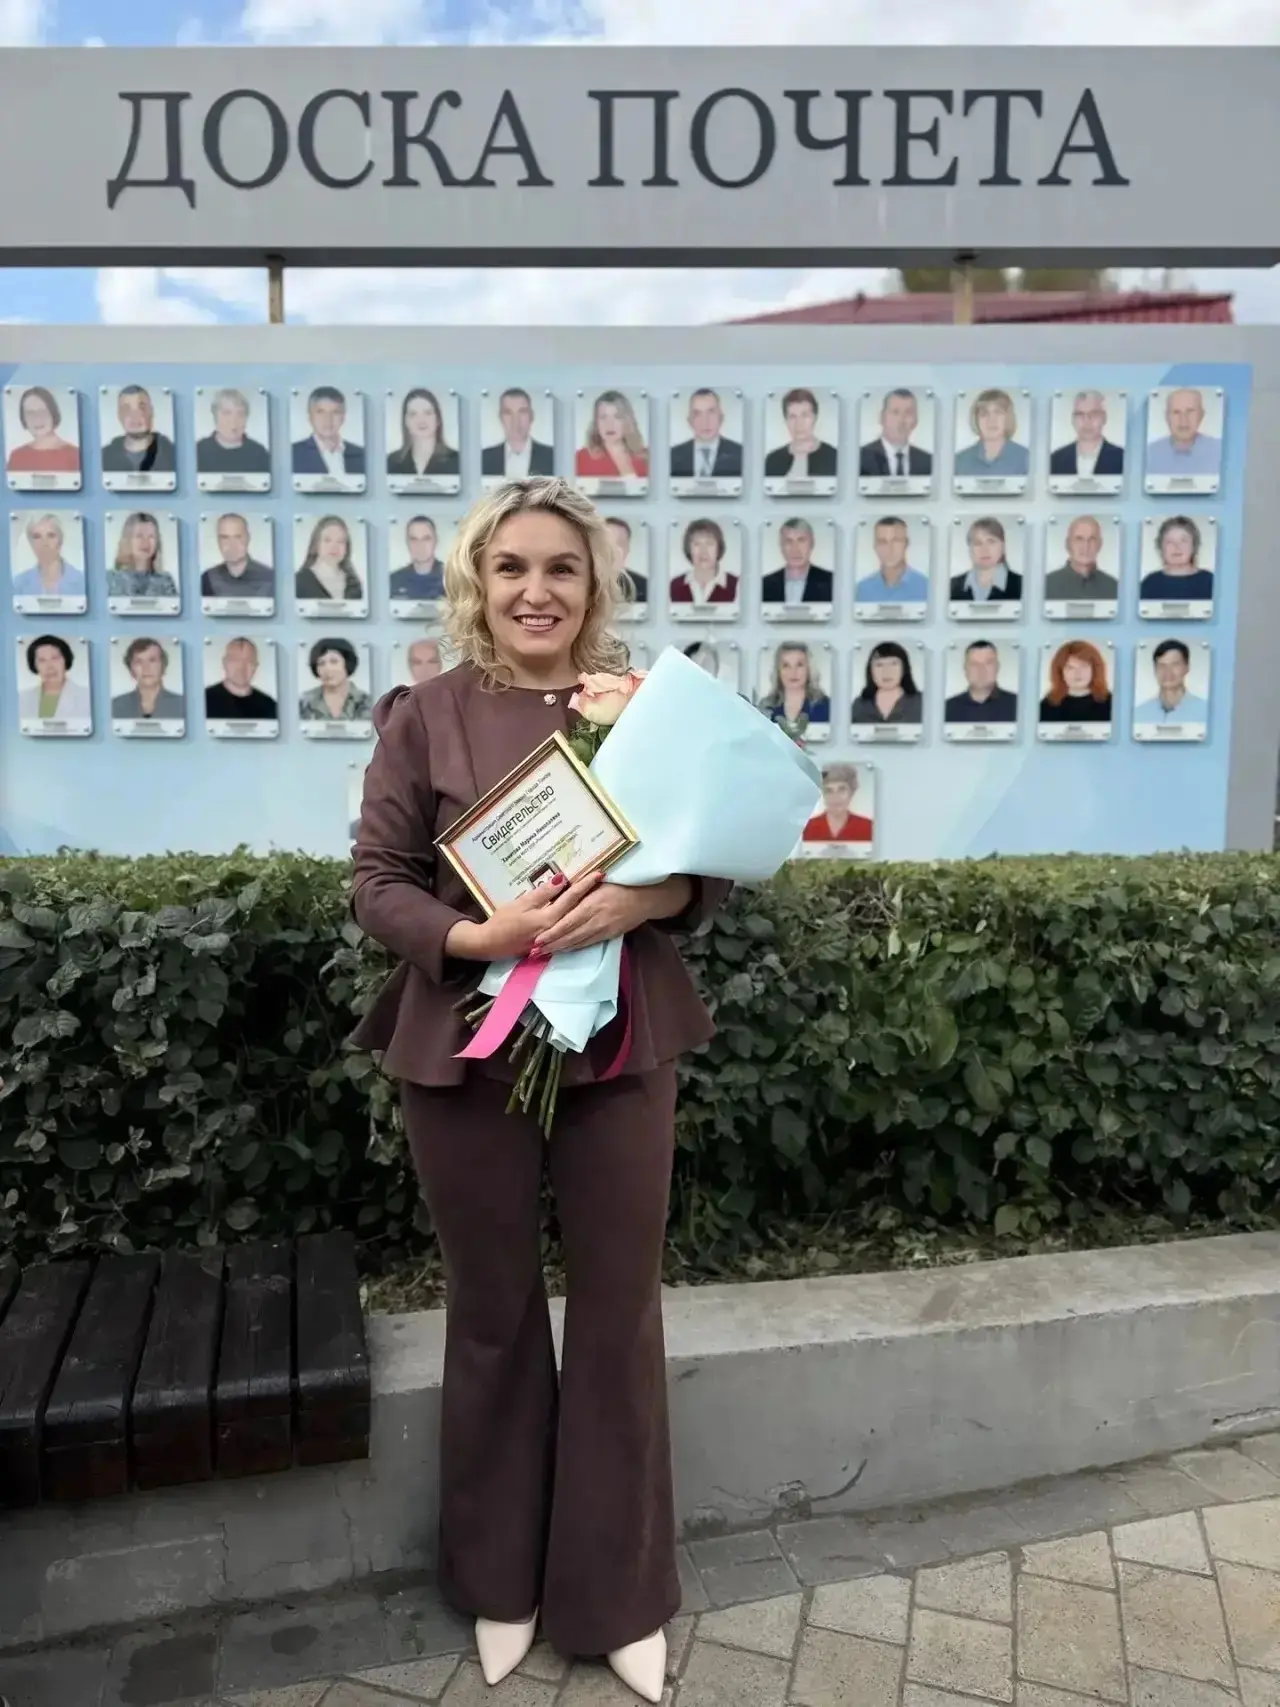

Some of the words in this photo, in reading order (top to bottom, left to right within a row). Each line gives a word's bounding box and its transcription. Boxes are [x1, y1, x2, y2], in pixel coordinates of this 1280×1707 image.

[108, 90, 553, 208] ДОСКА
[588, 88, 1129, 188] ПОЧЕТА
[481, 785, 555, 850] Свидетельство
